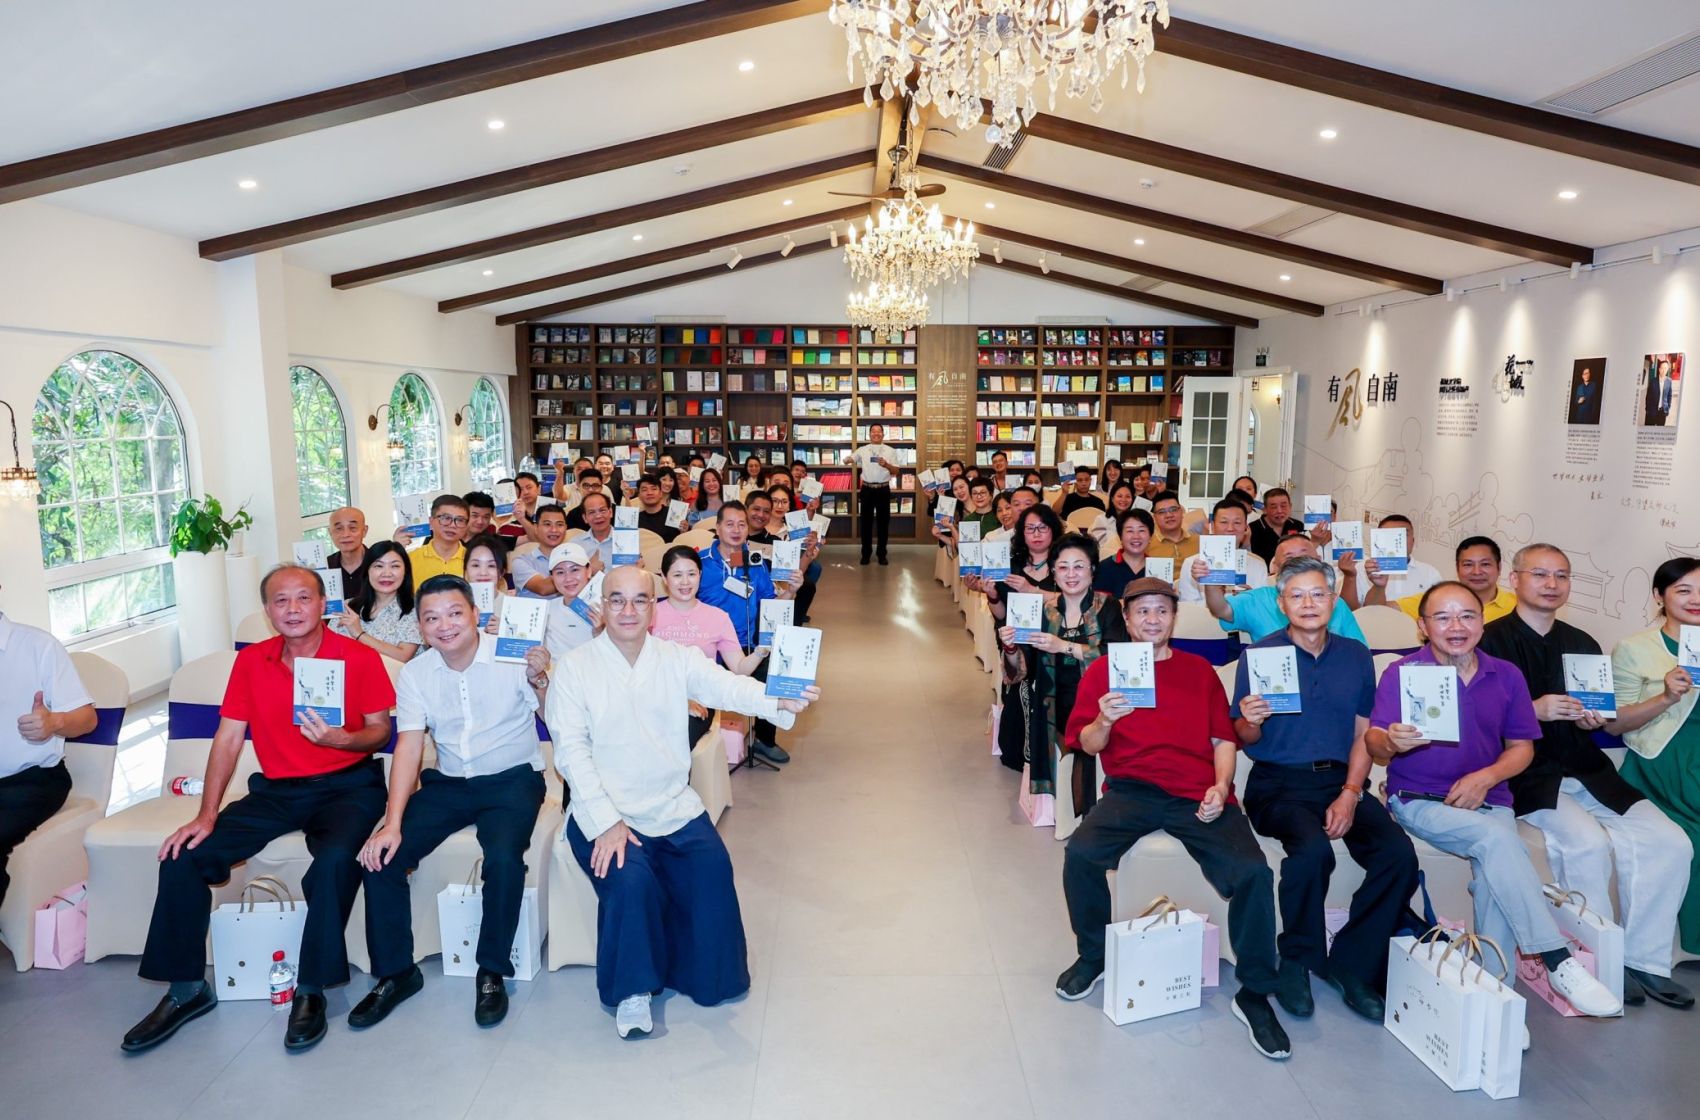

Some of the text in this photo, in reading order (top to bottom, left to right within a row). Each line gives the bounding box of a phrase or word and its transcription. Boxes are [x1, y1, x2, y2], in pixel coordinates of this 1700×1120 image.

[1174, 975, 1191, 983] BEST
[1166, 983, 1191, 992] WISHES
[1426, 1034, 1449, 1058] WISHES
[1434, 1033, 1449, 1050] BEST
